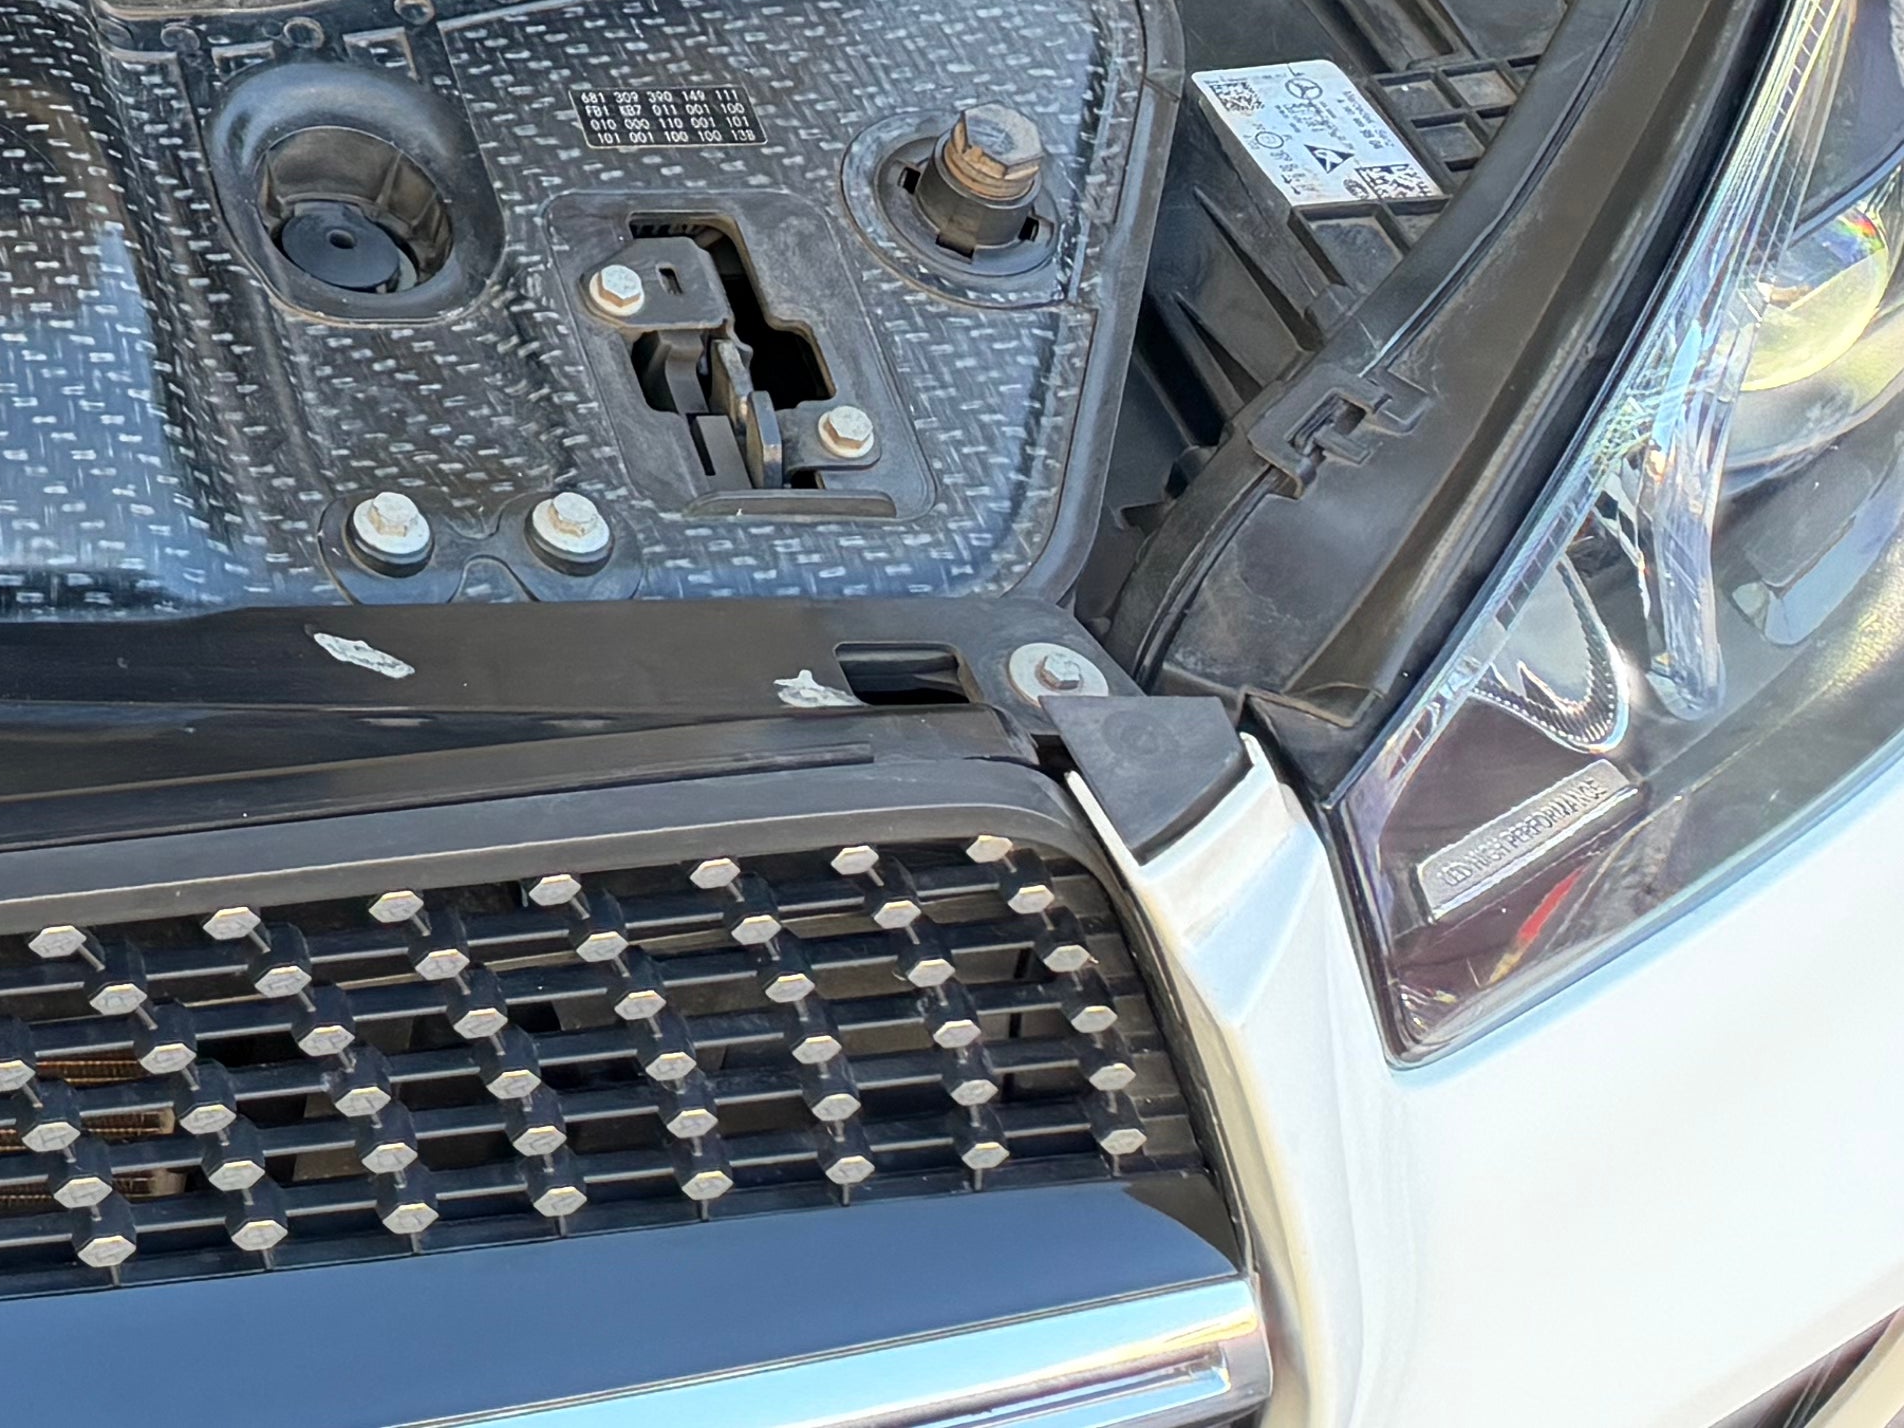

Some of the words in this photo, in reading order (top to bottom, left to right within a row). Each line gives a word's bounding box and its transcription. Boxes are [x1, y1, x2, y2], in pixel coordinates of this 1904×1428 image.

[581, 92, 605, 103] 681
[614, 91, 639, 103] 309
[646, 91, 673, 103] 390
[715, 89, 739, 100] 111
[585, 105, 609, 116] FB1
[652, 104, 677, 116] 011
[686, 104, 710, 115] 001
[720, 103, 745, 114] 100
[590, 119, 617, 130] 010
[624, 119, 650, 130] 000
[659, 118, 683, 129] 110
[690, 117, 716, 128] 001
[726, 116, 750, 127] 101
[597, 133, 621, 144] 101
[629, 132, 654, 143] 001
[664, 131, 689, 142] 100
[697, 130, 722, 142] 100
[1465, 837, 1511, 870] HIGH
[1500, 779, 1607, 849] PERFORMANCE
